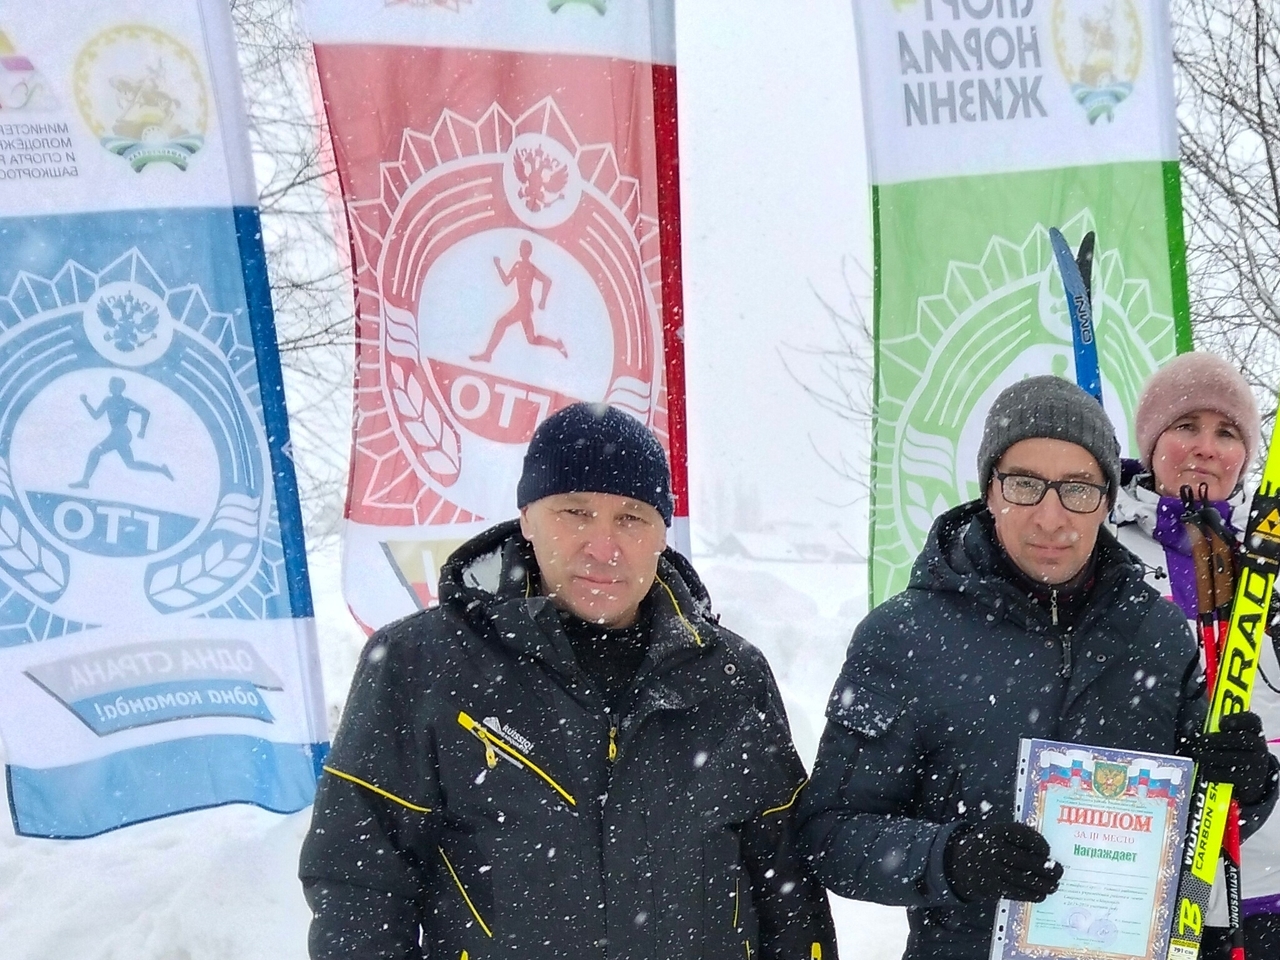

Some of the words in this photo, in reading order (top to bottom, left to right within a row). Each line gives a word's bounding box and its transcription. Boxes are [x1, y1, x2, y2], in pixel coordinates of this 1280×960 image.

[1057, 805, 1153, 833] ДИПЛОМ
[1074, 831, 1087, 839] ЗА
[1103, 834, 1135, 844] МЕСТО
[1195, 804, 1216, 871] CARBON
[1073, 844, 1138, 863] Награждает
[1228, 864, 1240, 929] ACTIVESONIC
